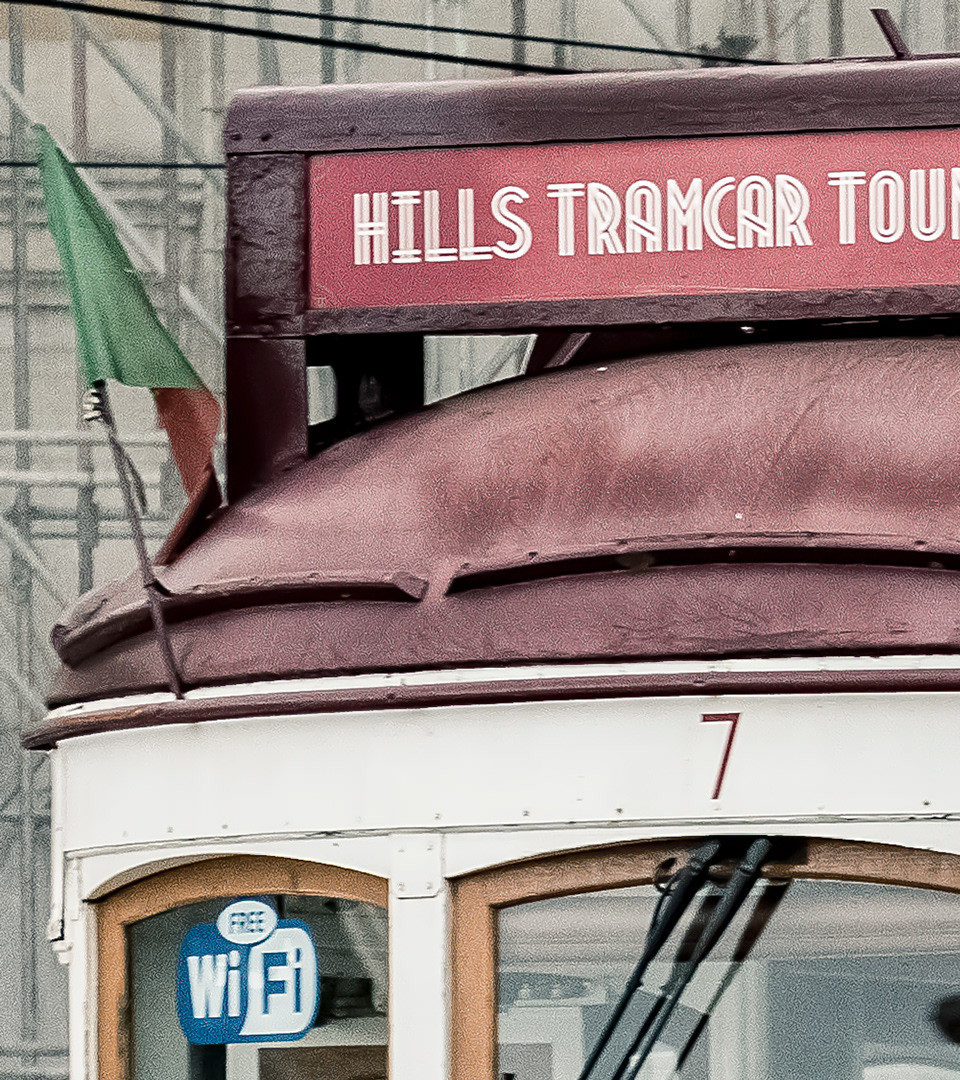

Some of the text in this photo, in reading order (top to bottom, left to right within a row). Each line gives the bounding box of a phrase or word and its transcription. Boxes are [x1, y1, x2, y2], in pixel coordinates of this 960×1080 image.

[353, 186, 532, 265] HILLS
[547, 174, 812, 256] TRAMCAR
[701, 713, 741, 800] 7
